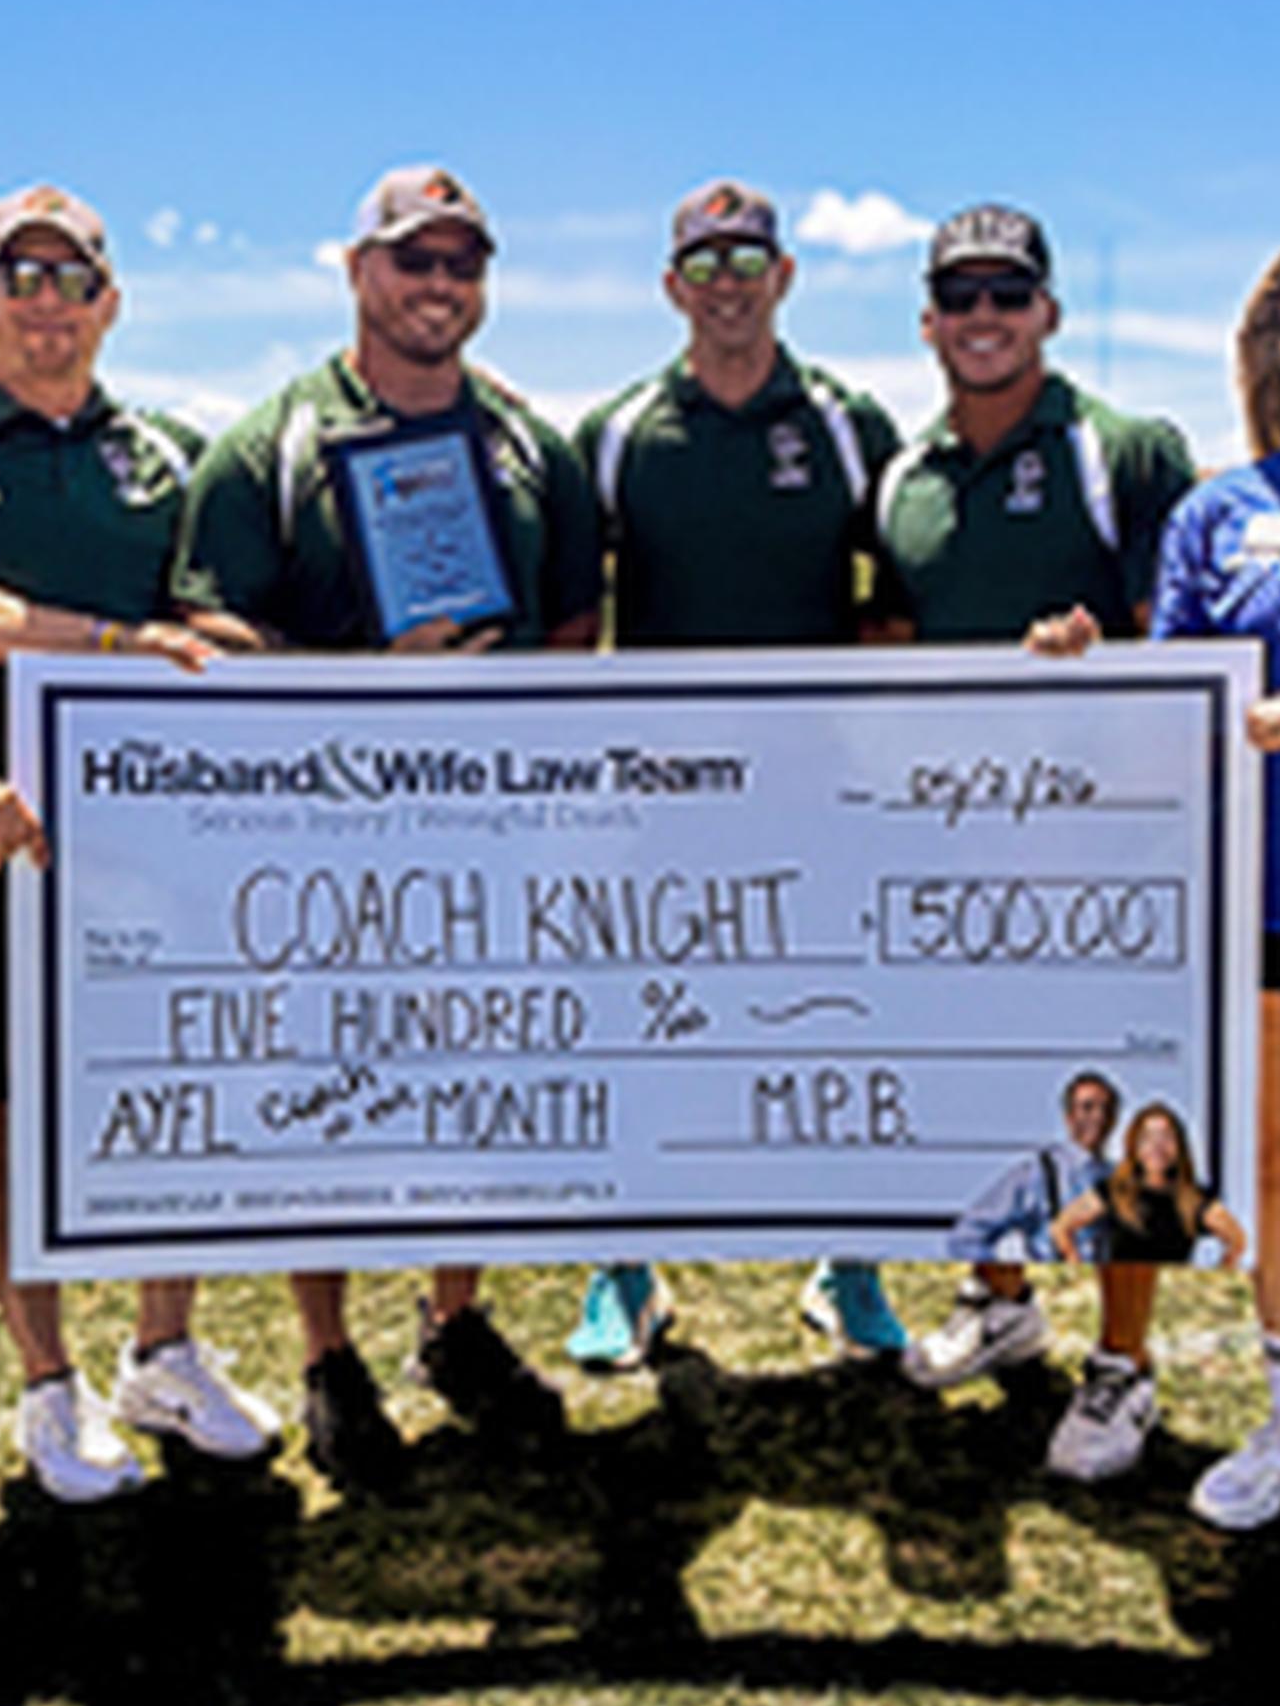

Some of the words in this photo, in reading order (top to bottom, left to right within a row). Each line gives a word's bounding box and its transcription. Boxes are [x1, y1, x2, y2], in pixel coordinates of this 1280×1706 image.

[82, 749, 320, 795] Husband
[372, 749, 488, 794] Wife
[493, 749, 599, 794] Law
[603, 748, 746, 793] Team
[234, 868, 487, 971] COACH
[525, 869, 801, 966] KNIGHT
[168, 983, 299, 1063] FIVE
[330, 983, 585, 1058] HUNDRED
[424, 1077, 609, 1151] MONTH
